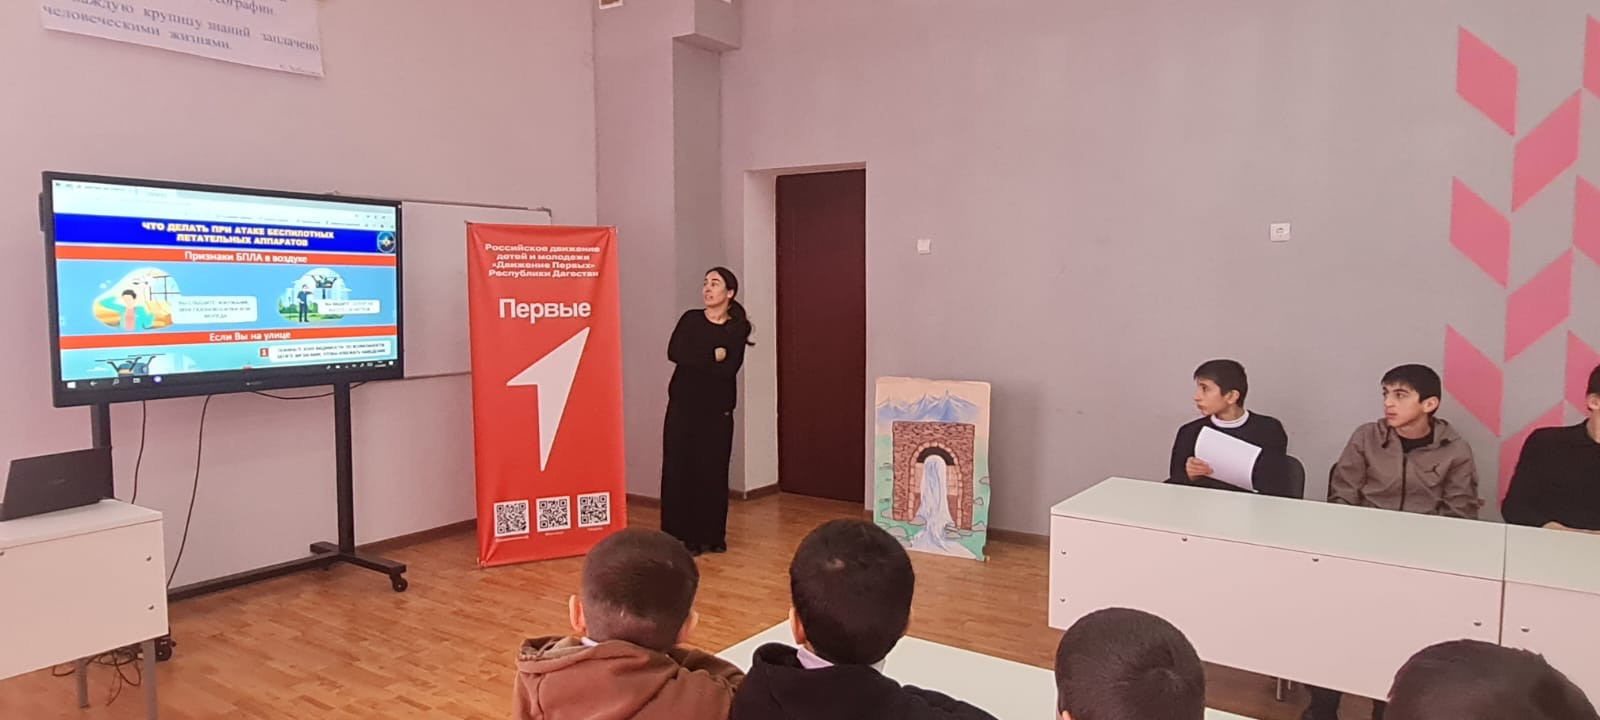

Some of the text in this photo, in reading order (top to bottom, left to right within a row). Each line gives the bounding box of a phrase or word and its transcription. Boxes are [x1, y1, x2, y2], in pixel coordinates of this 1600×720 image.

[209, 0, 277, 16] ографии.
[42, 5, 160, 36] человеческими
[71, 0, 319, 51] ждую крупицу знаний заплачено
[142, 221, 335, 239] ЧТО ДЕЛАТЬ ПРИ АТАКЕ БЕСПИЛОТНЫХ
[176, 233, 309, 247] ЛЕТАТЕЛЬНЫХ АППАРАТОВ
[485, 243, 600, 253] Российское движение
[184, 251, 234, 262] Признаки
[236, 252, 263, 262] БПЛА
[273, 255, 308, 264] воздухе
[496, 253, 528, 262] детей
[492, 261, 596, 271] «Движение Первых»
[488, 269, 599, 279] Республики Дагестан
[499, 298, 591, 324] Первые
[209, 332, 233, 342] Если
[234, 332, 249, 341] Вы
[263, 332, 292, 341] улице
